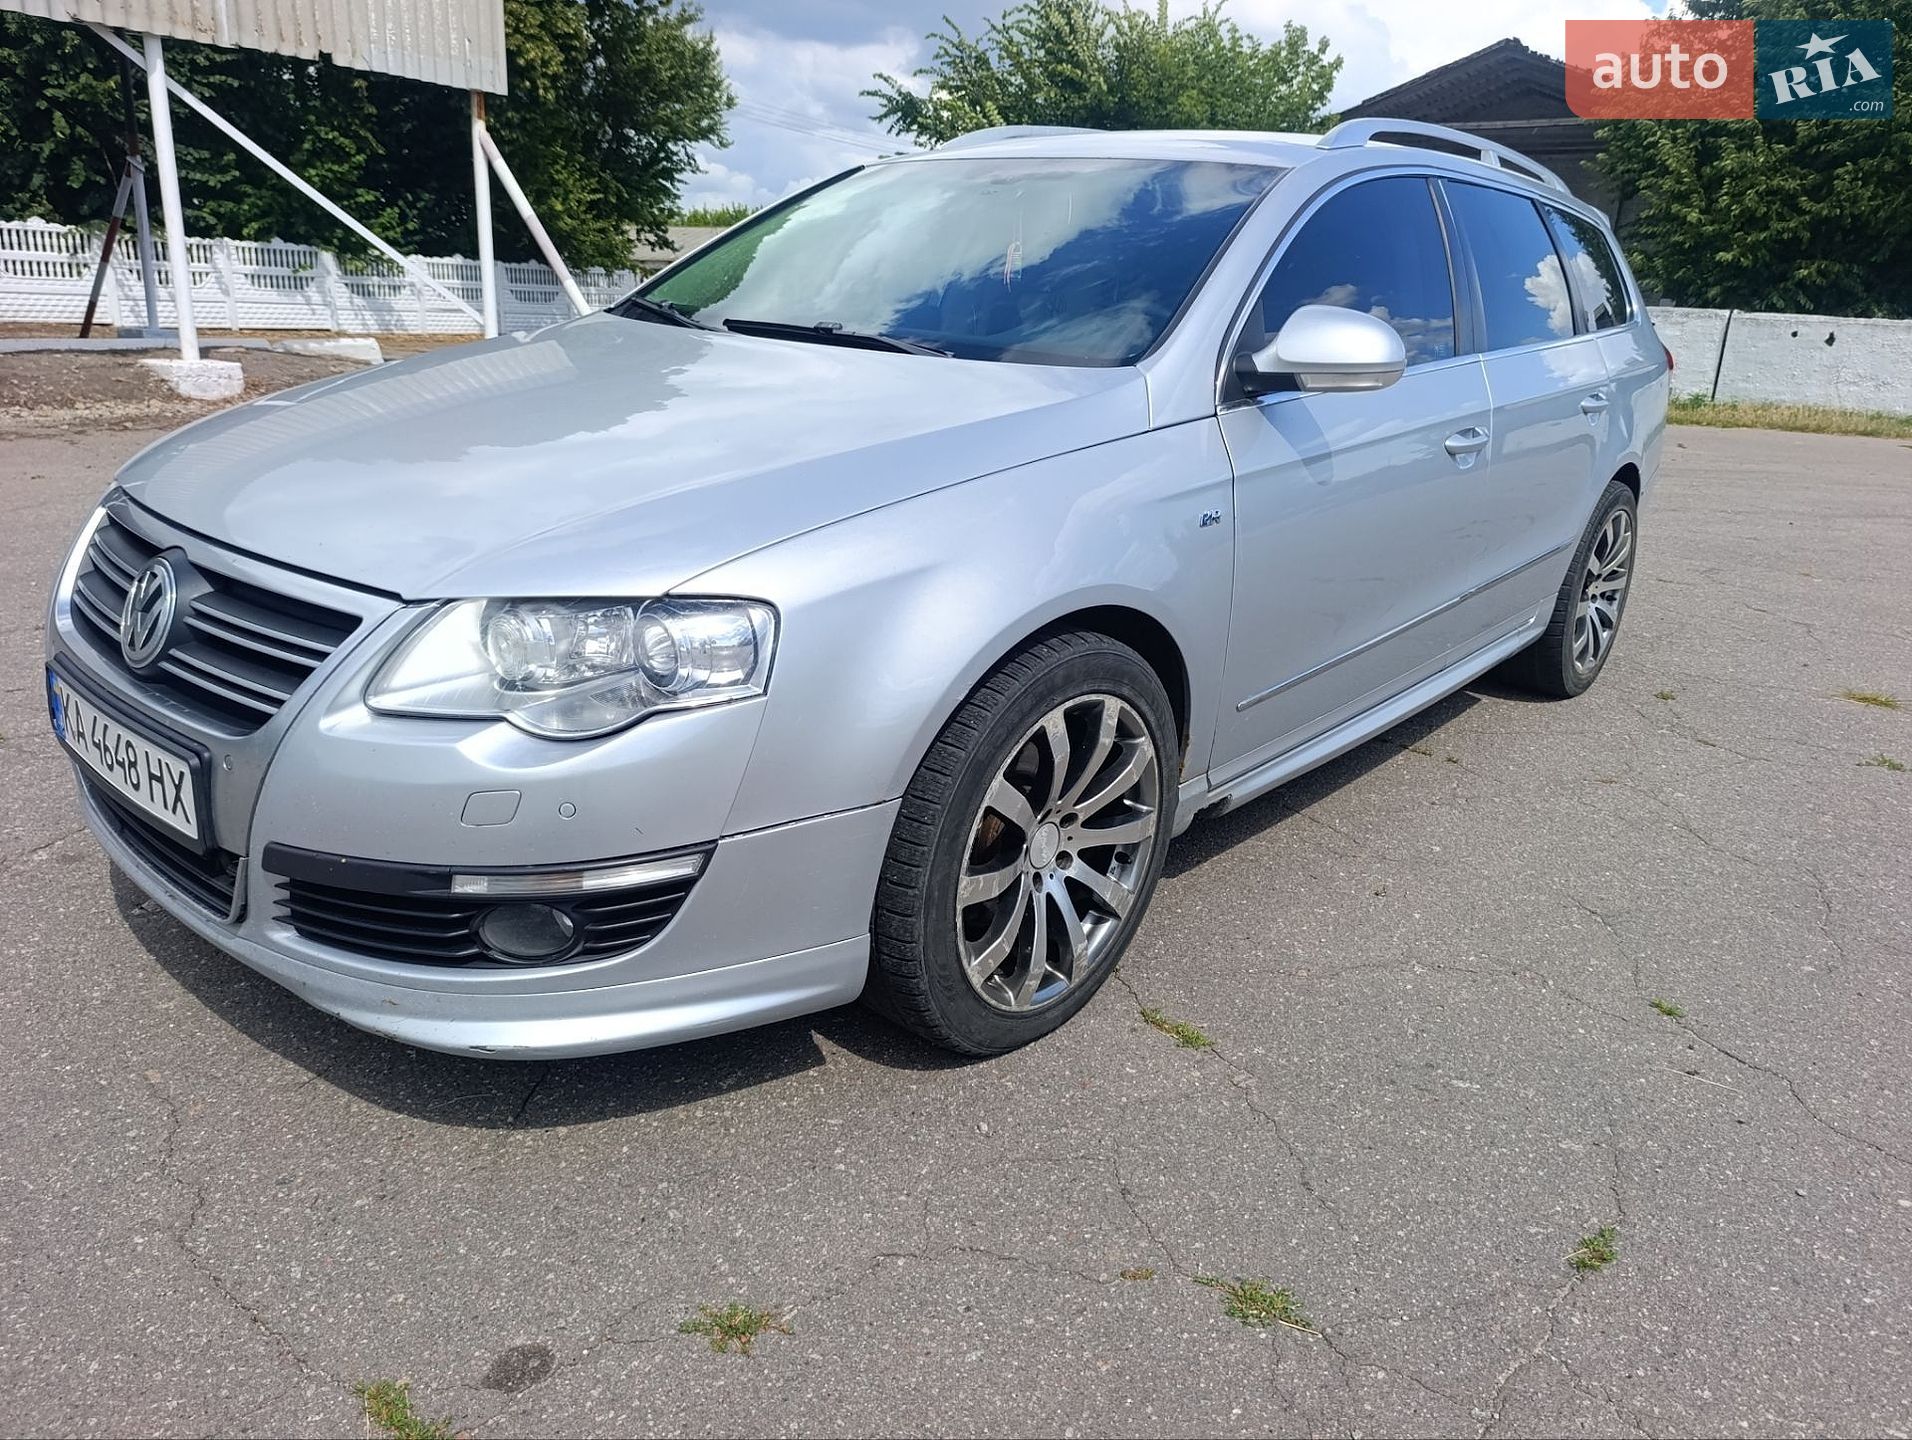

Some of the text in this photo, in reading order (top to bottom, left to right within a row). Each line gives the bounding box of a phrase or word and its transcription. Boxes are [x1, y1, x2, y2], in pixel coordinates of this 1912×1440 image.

[60, 686, 192, 825] KA 4648 HX
